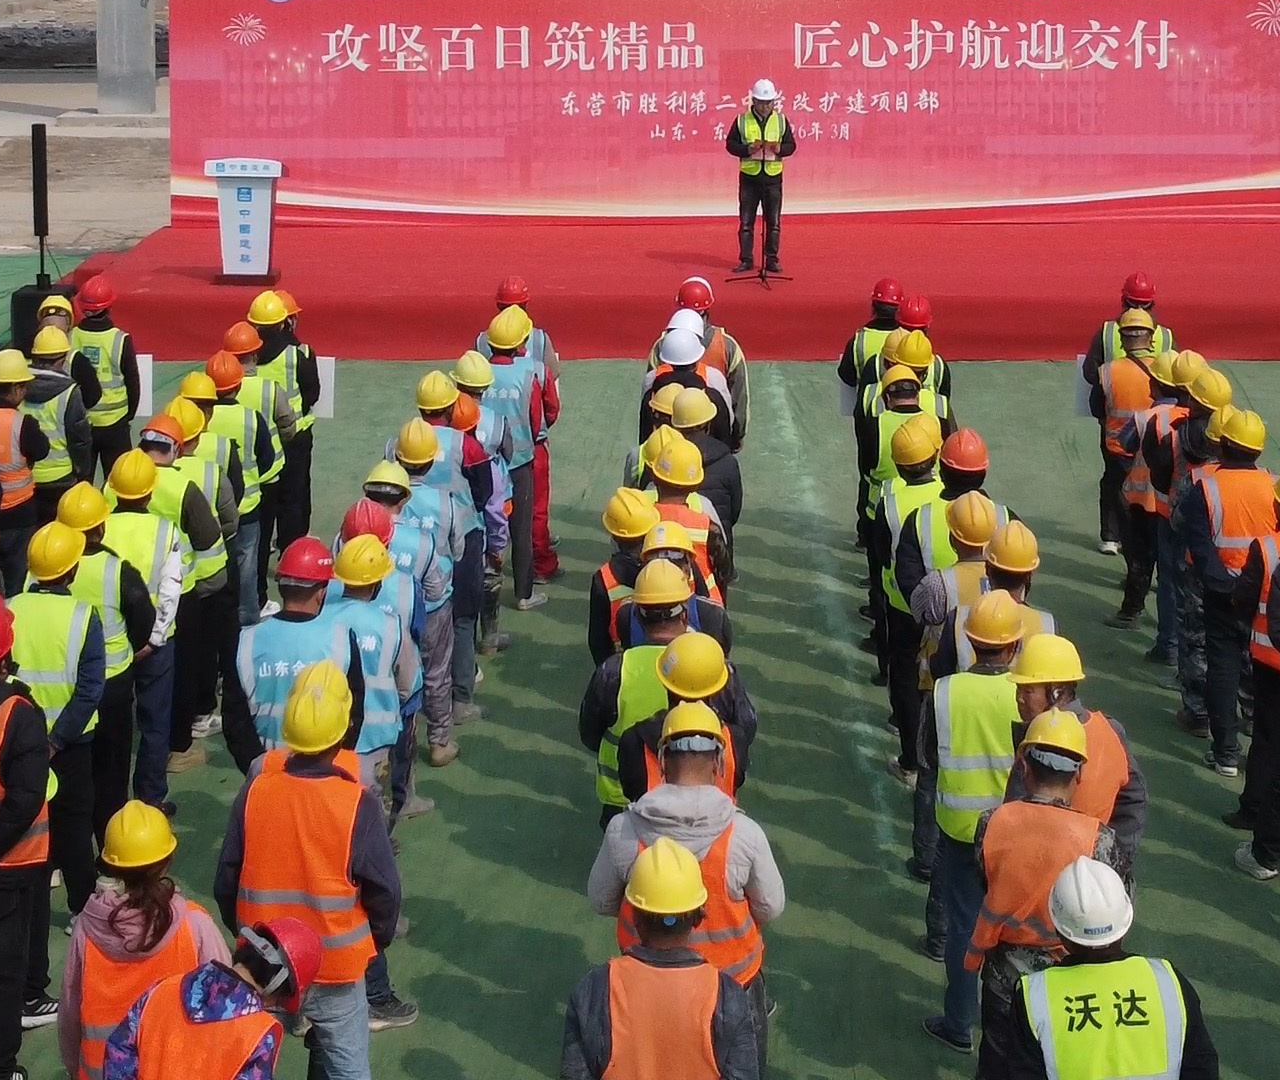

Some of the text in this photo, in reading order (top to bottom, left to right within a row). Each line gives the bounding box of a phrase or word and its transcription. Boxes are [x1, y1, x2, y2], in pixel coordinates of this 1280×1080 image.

[321, 19, 1178, 73] 攻坚百日筑精品 匠心护航迎交付
[258, 661, 307, 677] 山东金
[1064, 989, 1150, 1033] 沃达
